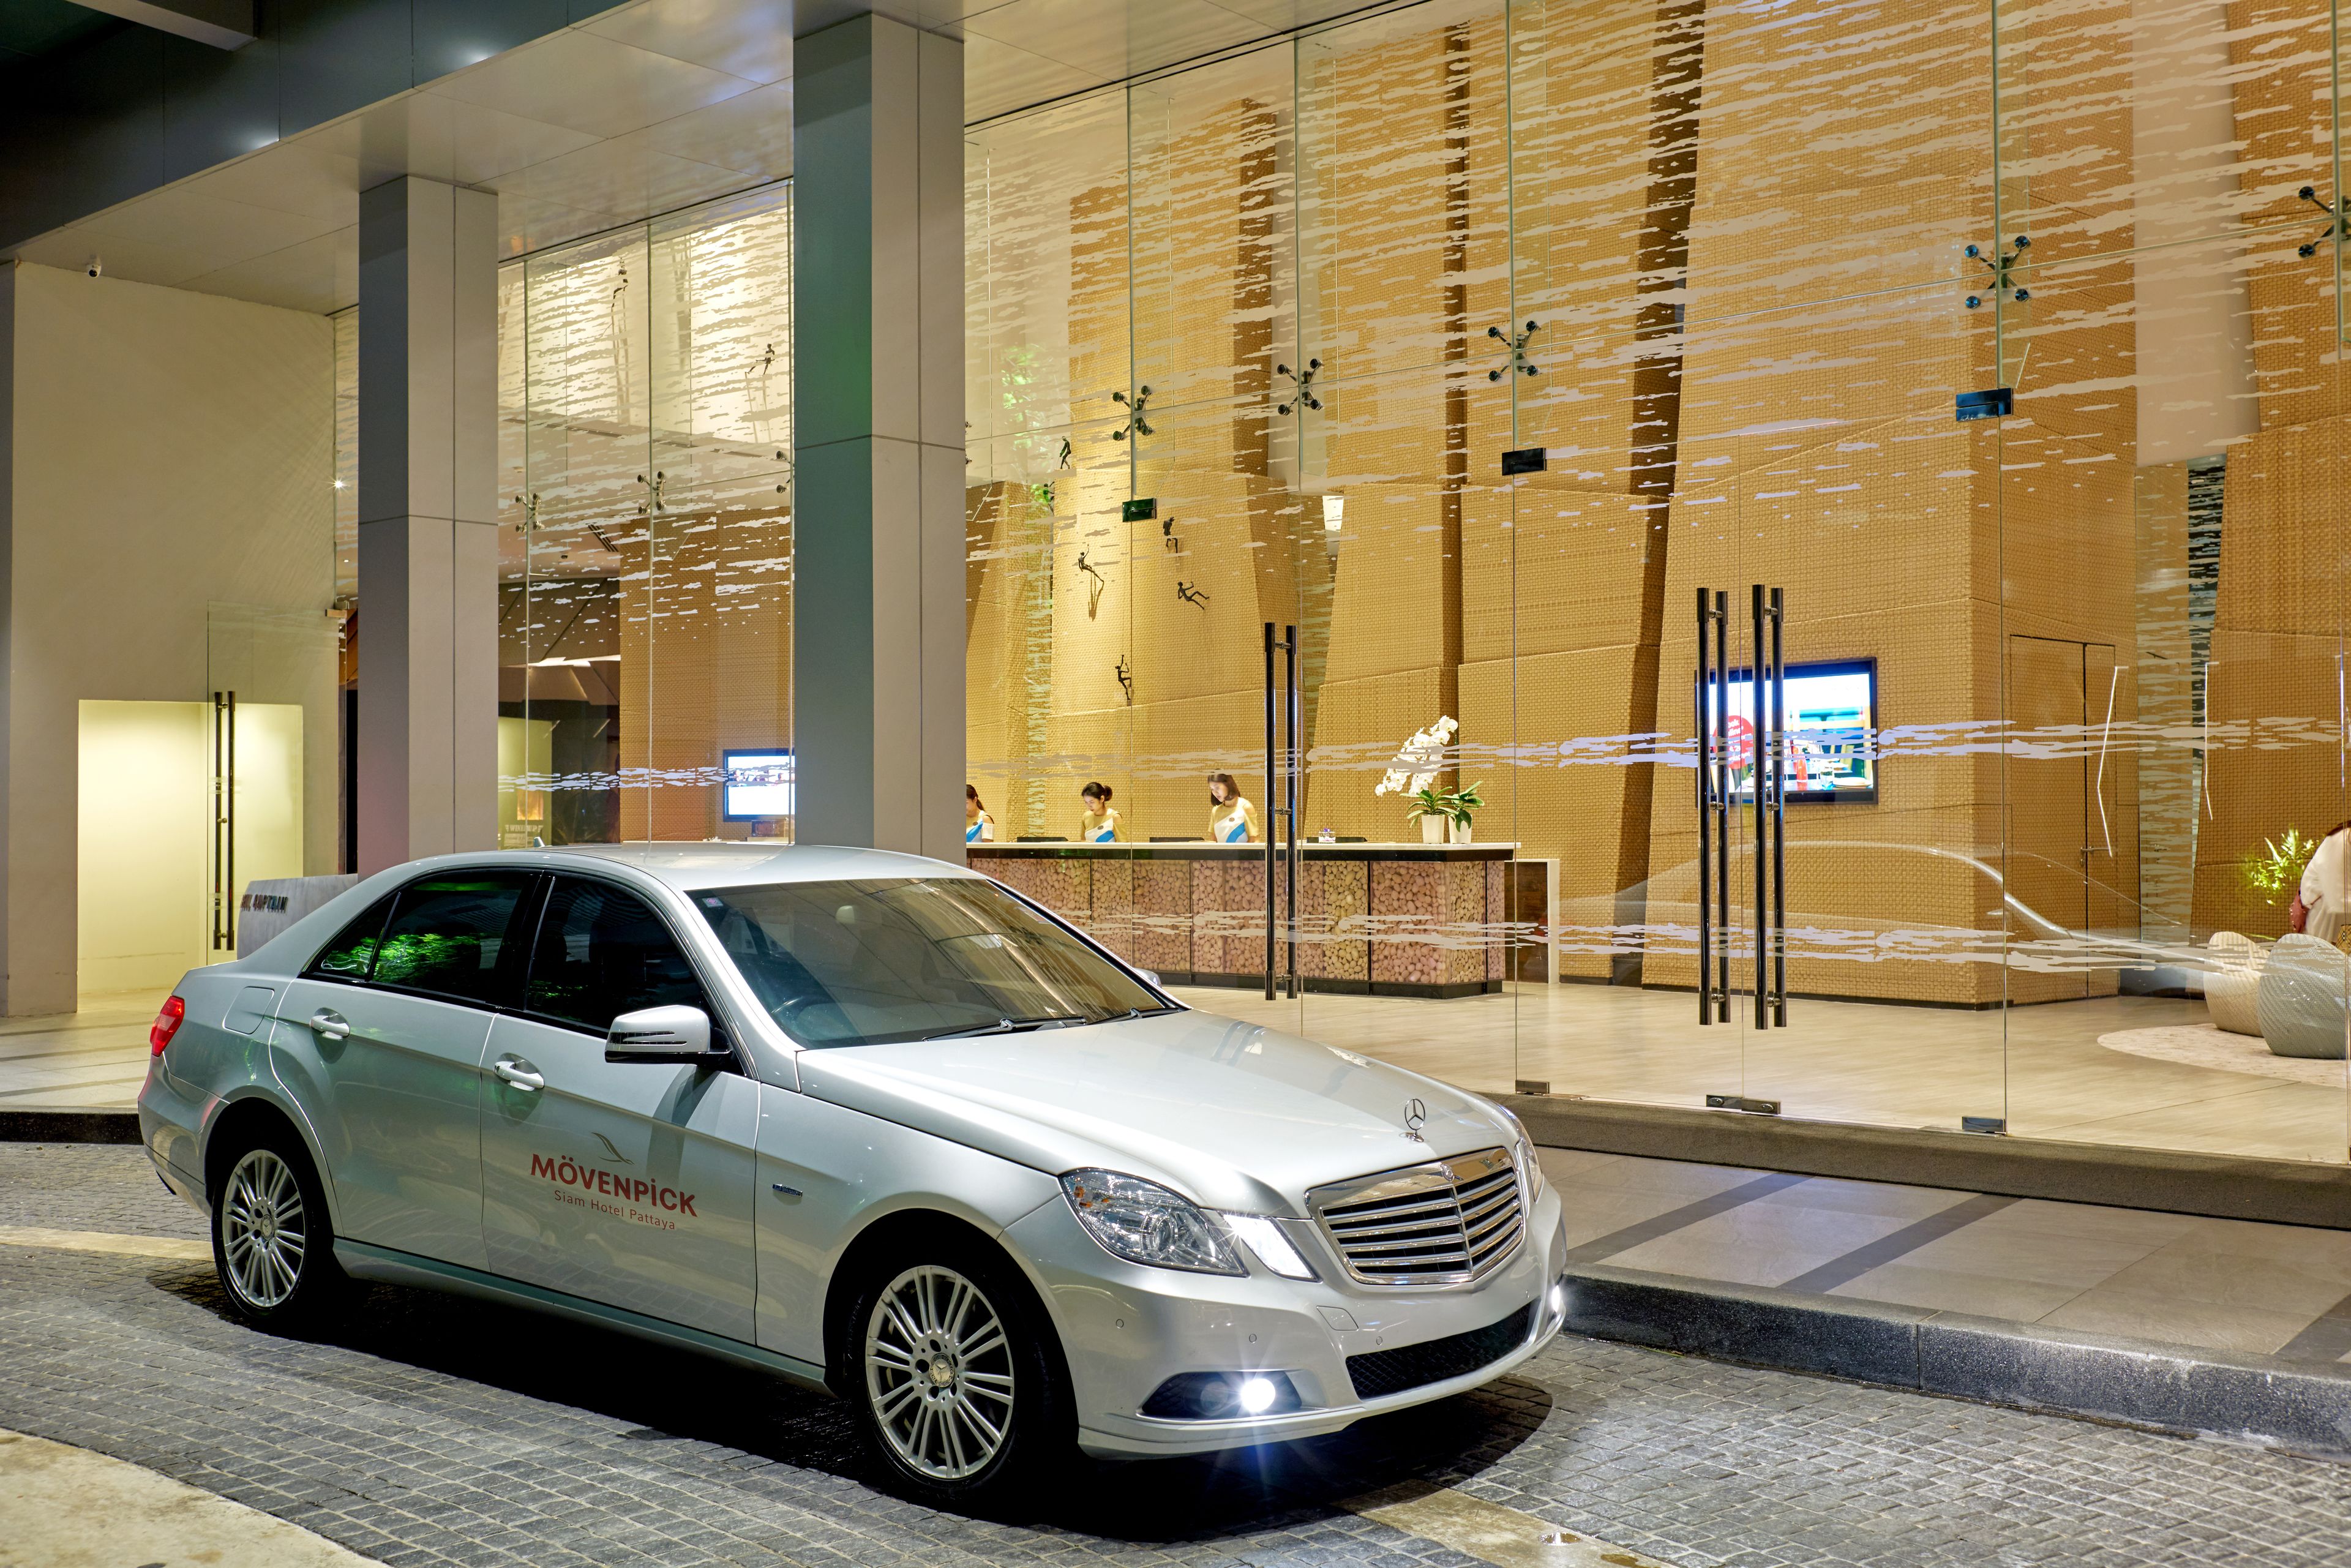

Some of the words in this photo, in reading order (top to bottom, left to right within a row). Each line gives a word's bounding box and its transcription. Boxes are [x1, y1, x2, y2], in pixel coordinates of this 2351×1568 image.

[554, 1190, 585, 1207] Siam
[590, 1199, 624, 1217] Hotel
[629, 1209, 676, 1231] Pattaya
